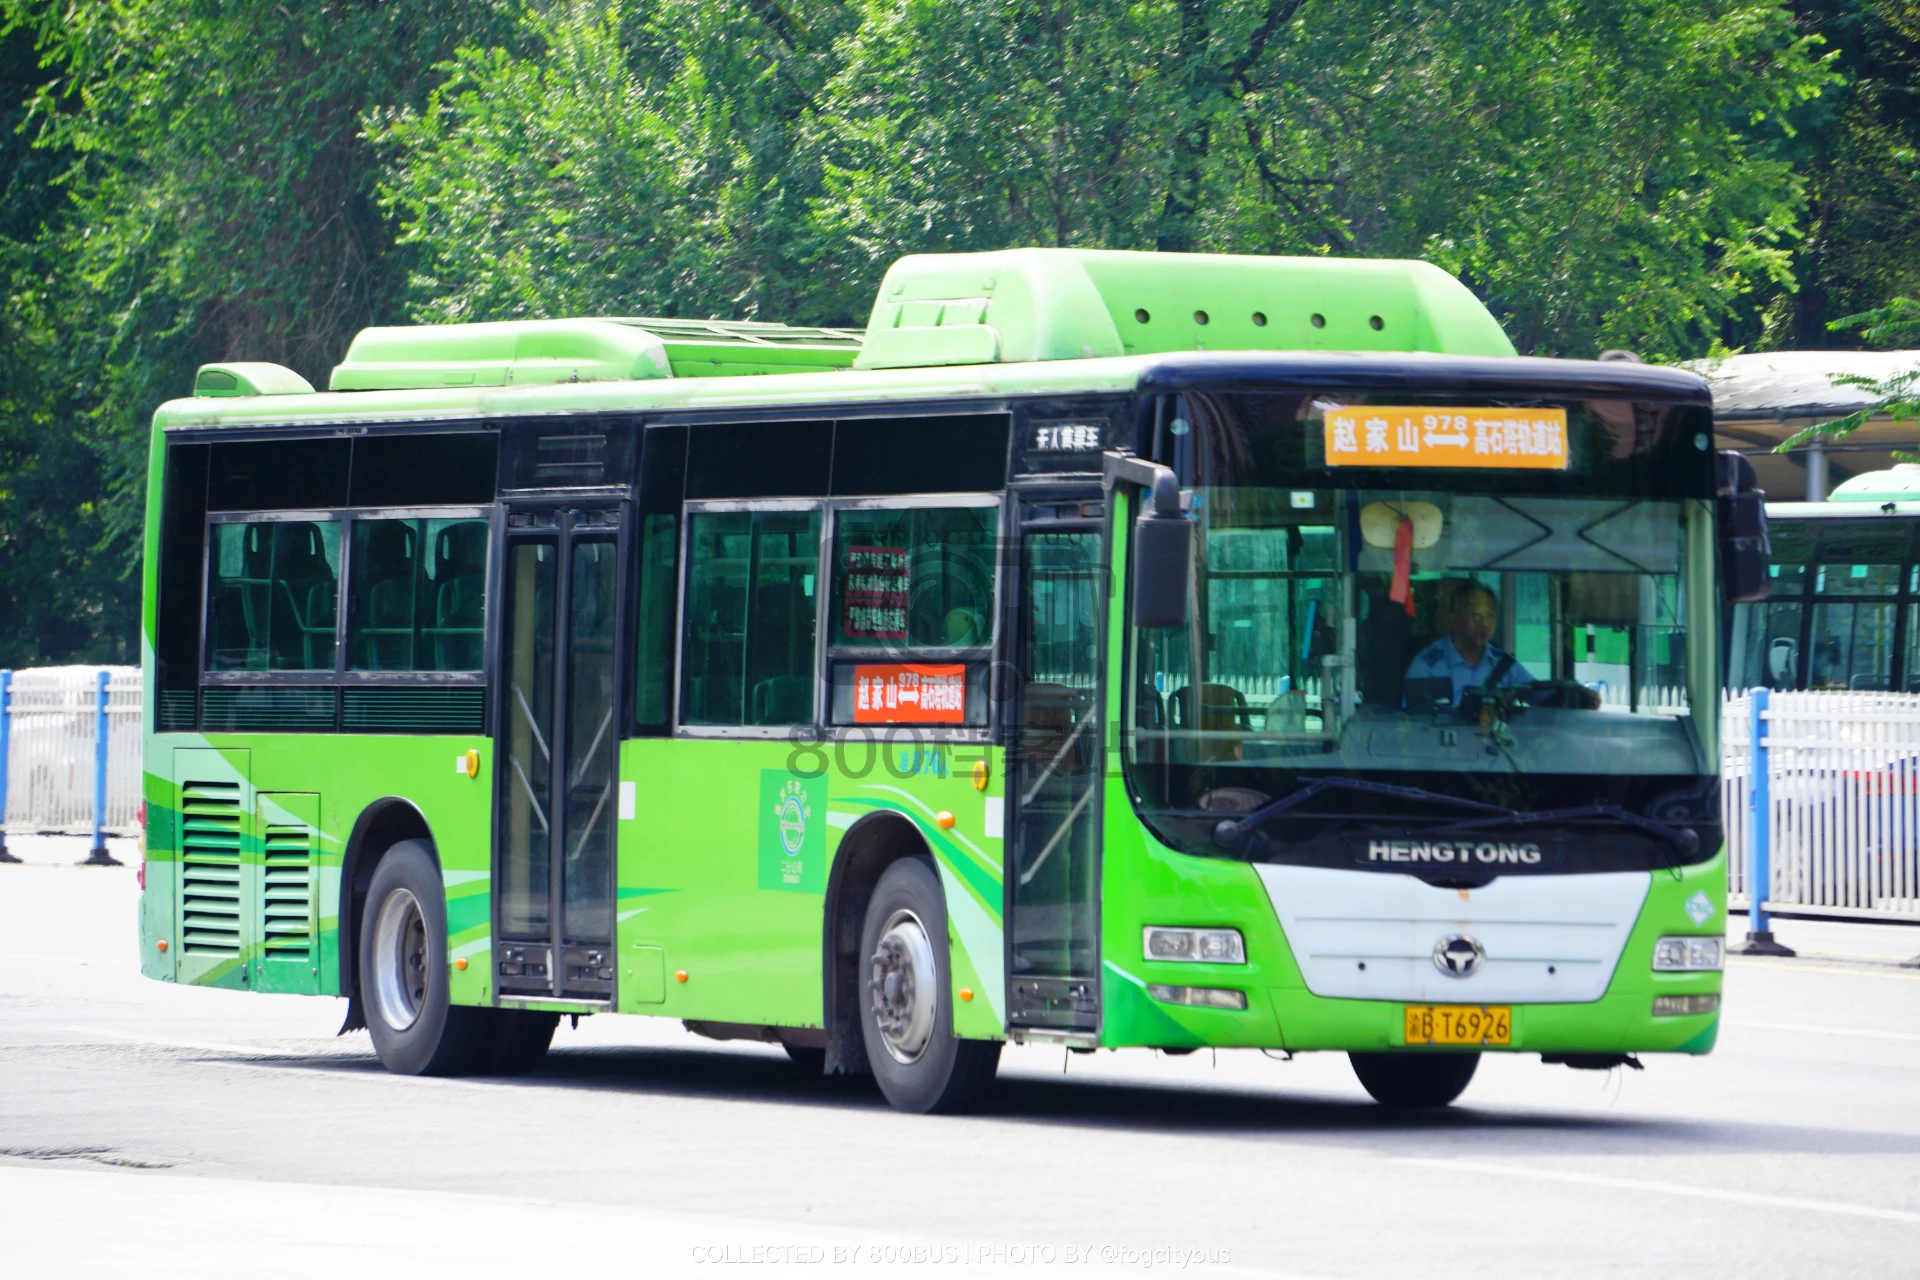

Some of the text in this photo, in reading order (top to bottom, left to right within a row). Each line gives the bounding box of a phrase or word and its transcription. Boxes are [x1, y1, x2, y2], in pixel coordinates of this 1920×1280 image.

[1333, 416, 1420, 453] 赵家山
[1423, 415, 1468, 431] 978
[857, 675, 898, 711] 赵家山
[898, 673, 920, 687] 978
[1368, 841, 1541, 864] HENGTONG
